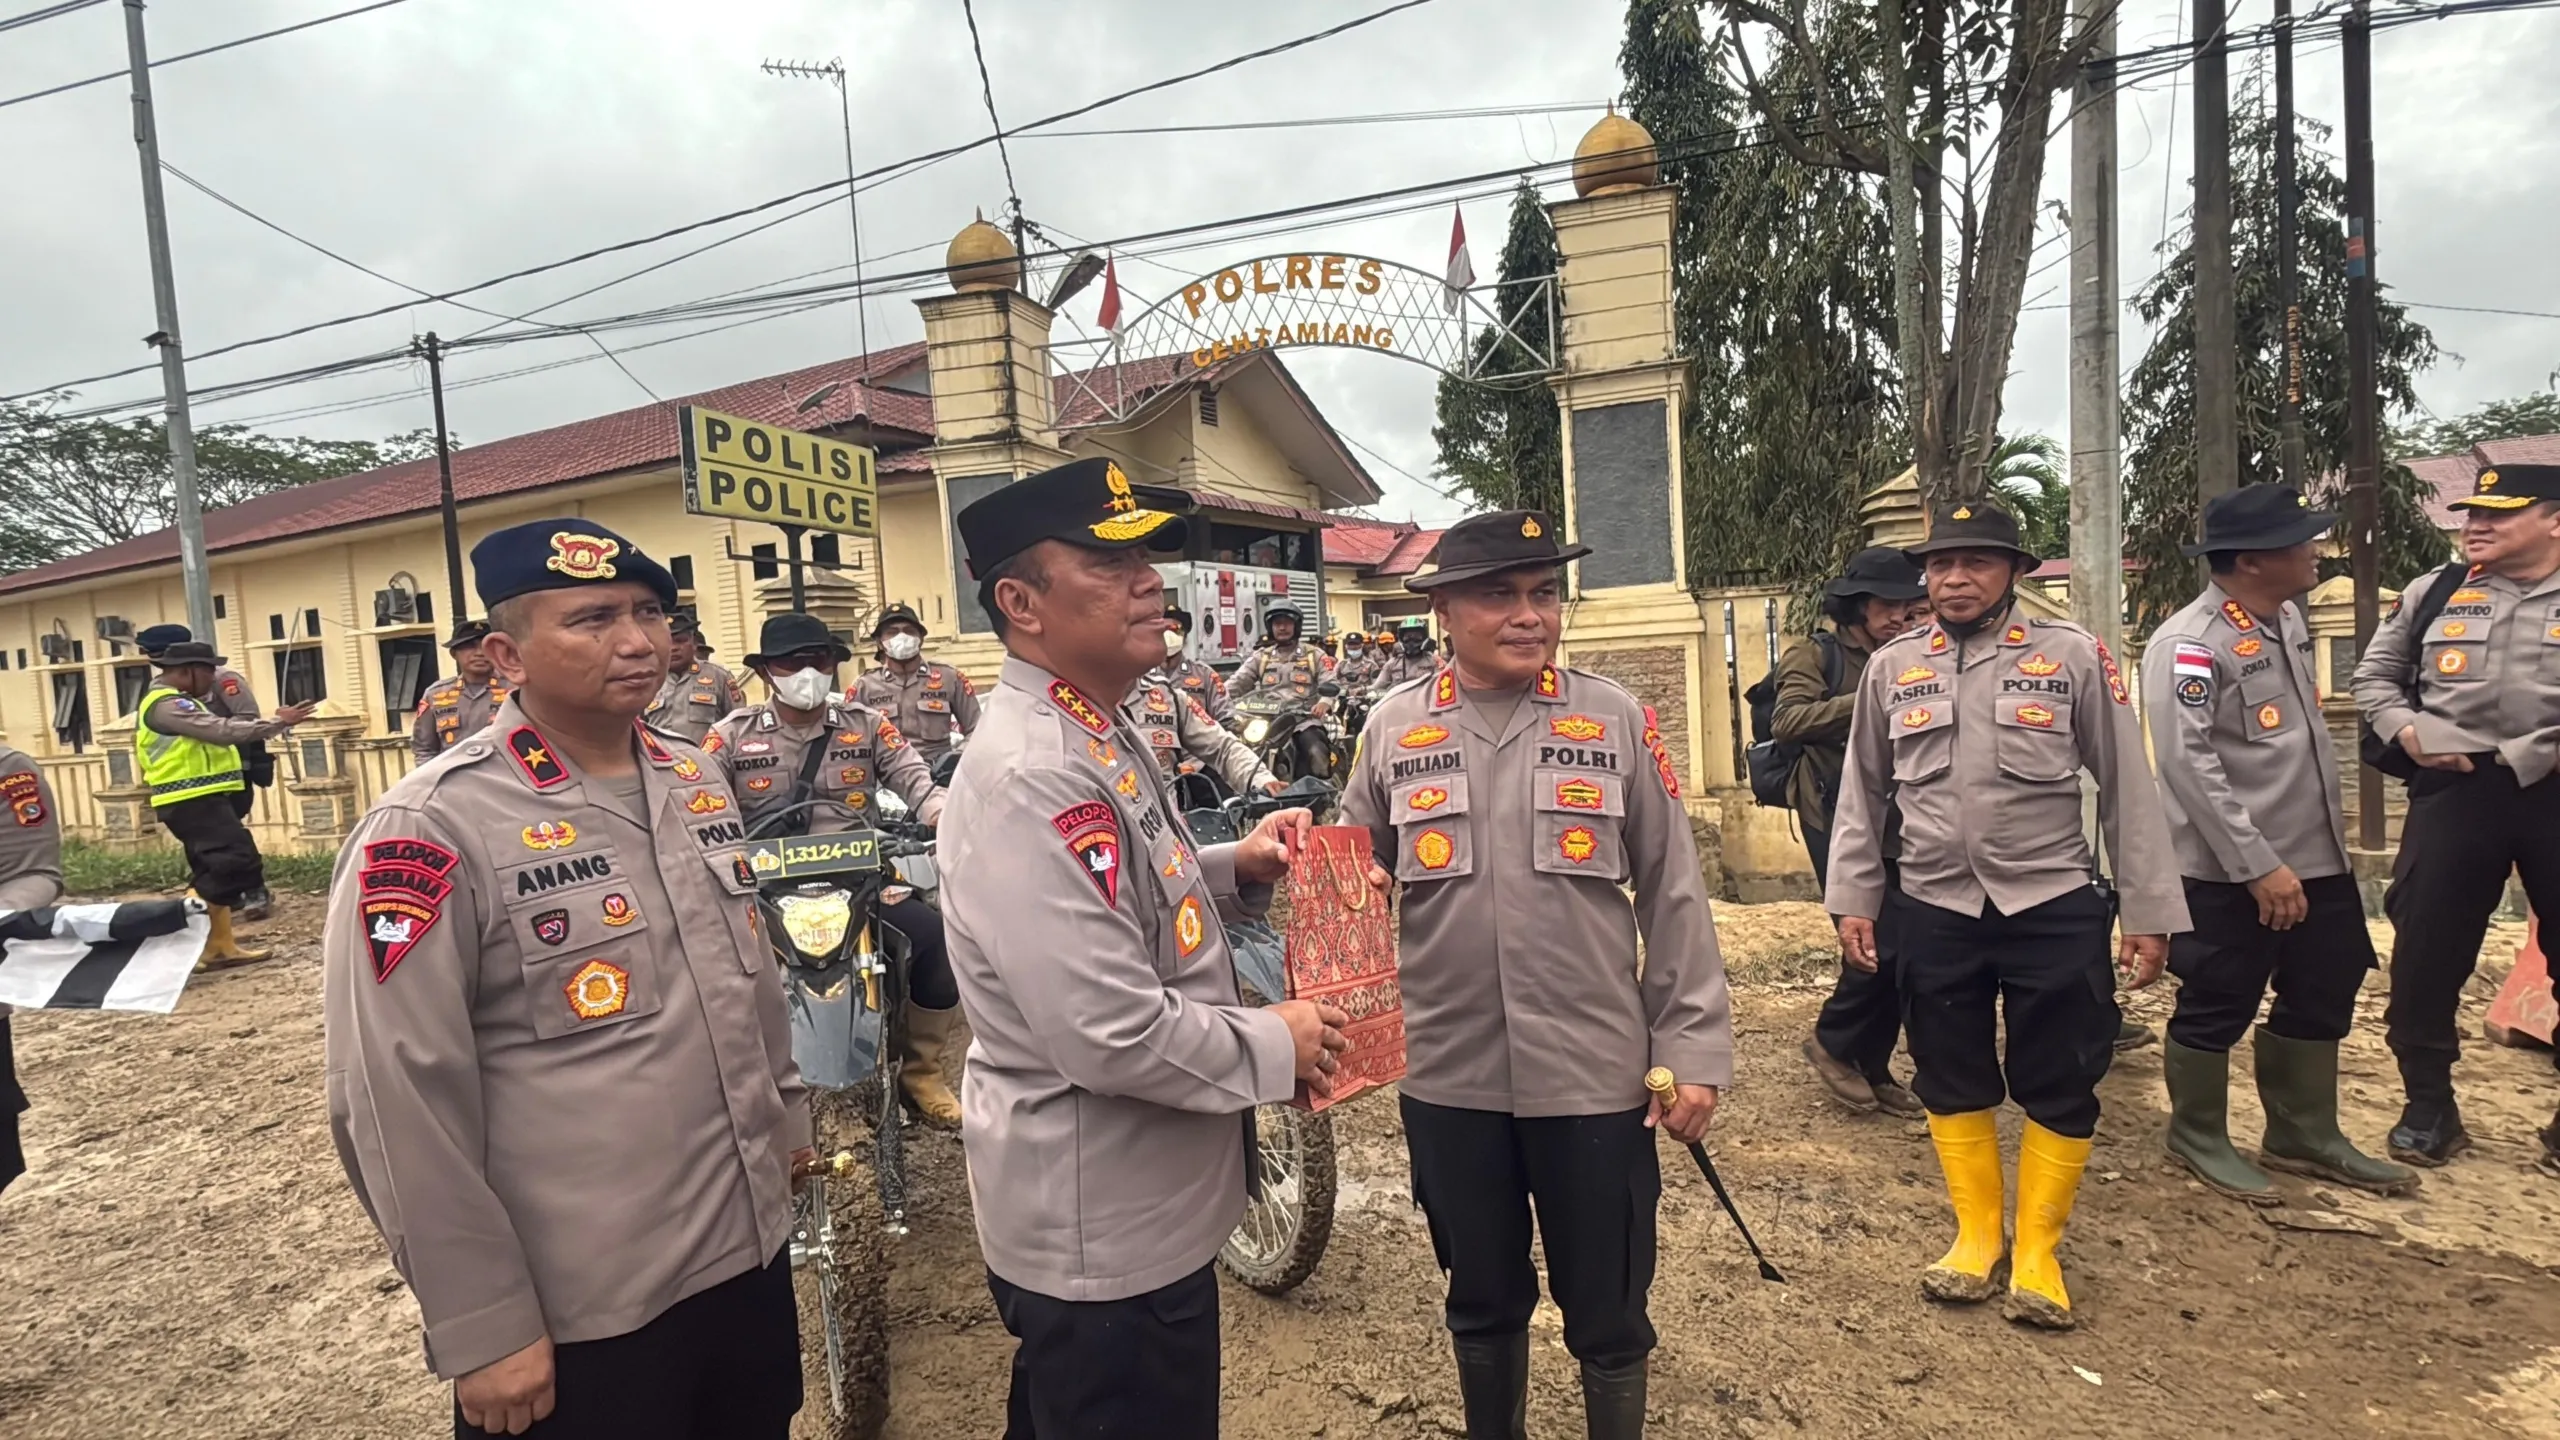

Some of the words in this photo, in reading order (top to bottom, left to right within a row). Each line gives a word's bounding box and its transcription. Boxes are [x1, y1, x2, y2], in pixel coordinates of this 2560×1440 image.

[1182, 255, 1383, 320] POLRES
[705, 416, 868, 485] POLISI
[709, 469, 872, 528] POLICE
[920, 691, 947, 699] POLRI
[1892, 683, 1946, 704] ASRIL
[2003, 679, 2070, 695] POLRI
[869, 694, 894, 705] DODY
[1144, 713, 1174, 725] POLRI
[830, 748, 872, 761] POLRI
[1392, 751, 1461, 779] MULIADI
[1540, 747, 1617, 770] POLRI
[372, 843, 450, 872] PELOPOR
[785, 840, 873, 865] 13124-07
[517, 854, 611, 896] ANANG
[798, 881, 832, 890] HONDA
